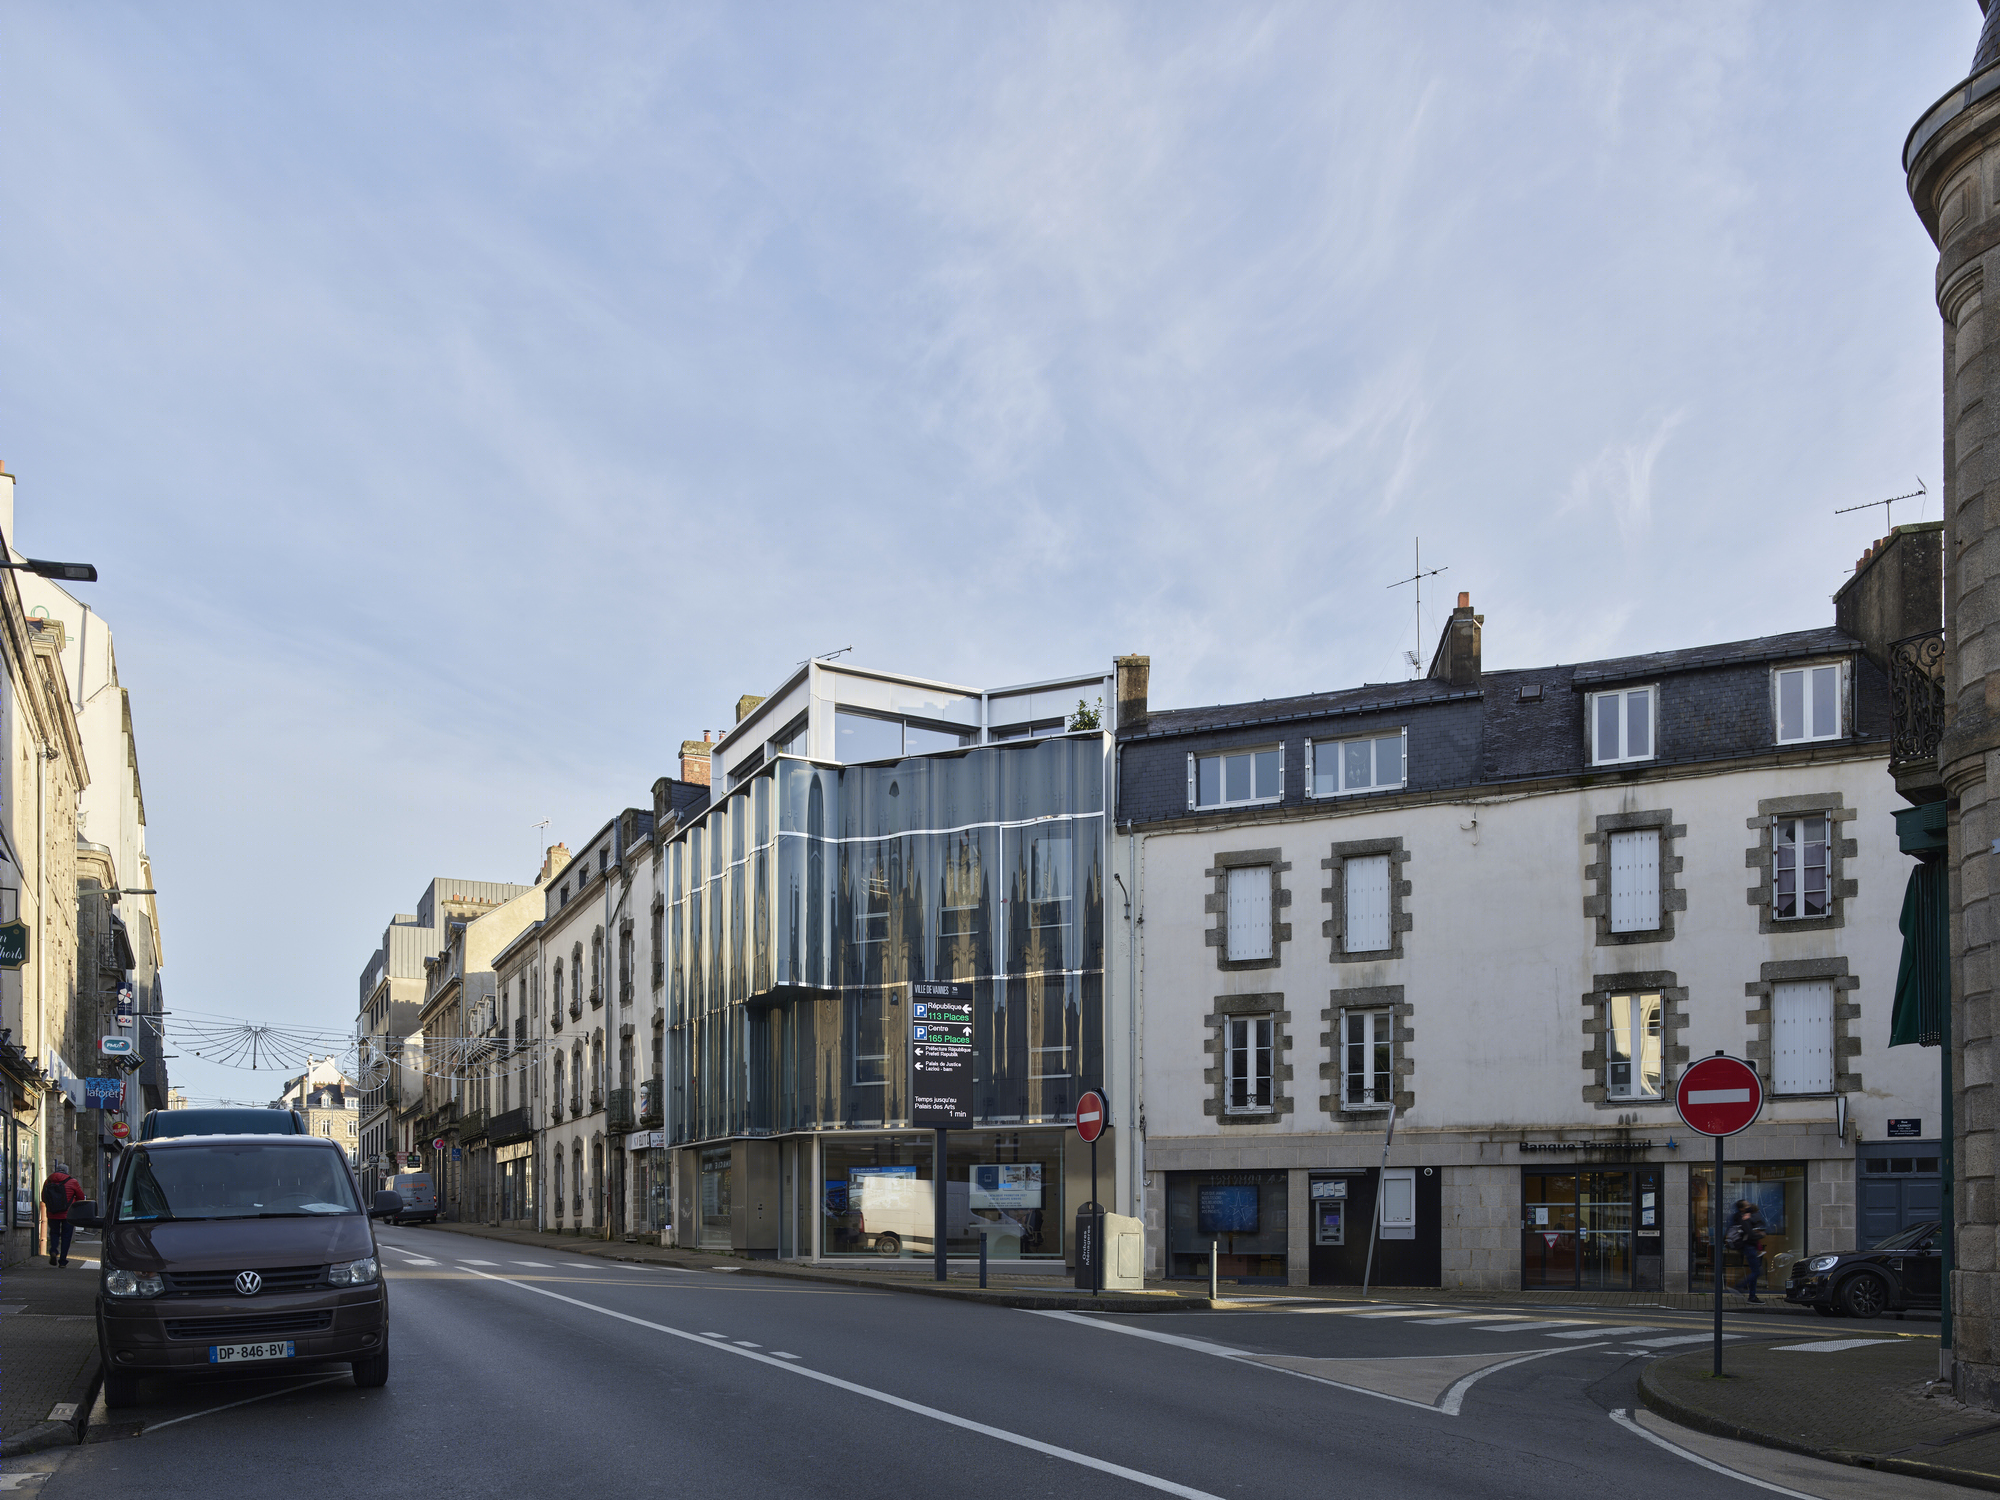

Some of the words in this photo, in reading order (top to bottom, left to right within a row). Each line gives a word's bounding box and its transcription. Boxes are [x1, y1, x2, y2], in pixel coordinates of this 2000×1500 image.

[914, 984, 926, 994] VILLE
[926, 985, 932, 994] DE
[932, 986, 950, 995] VANNES
[916, 1006, 925, 1016] P
[928, 1002, 962, 1011] République
[943, 1012, 969, 1021] Places
[916, 1028, 925, 1038] P
[944, 1035, 970, 1043] Places
[87, 1087, 119, 1099] laforêt
[1519, 1142, 1575, 1153] Banque
[1580, 1140, 1651, 1151] Tarneaud
[219, 1344, 284, 1360] DP-846-BV
